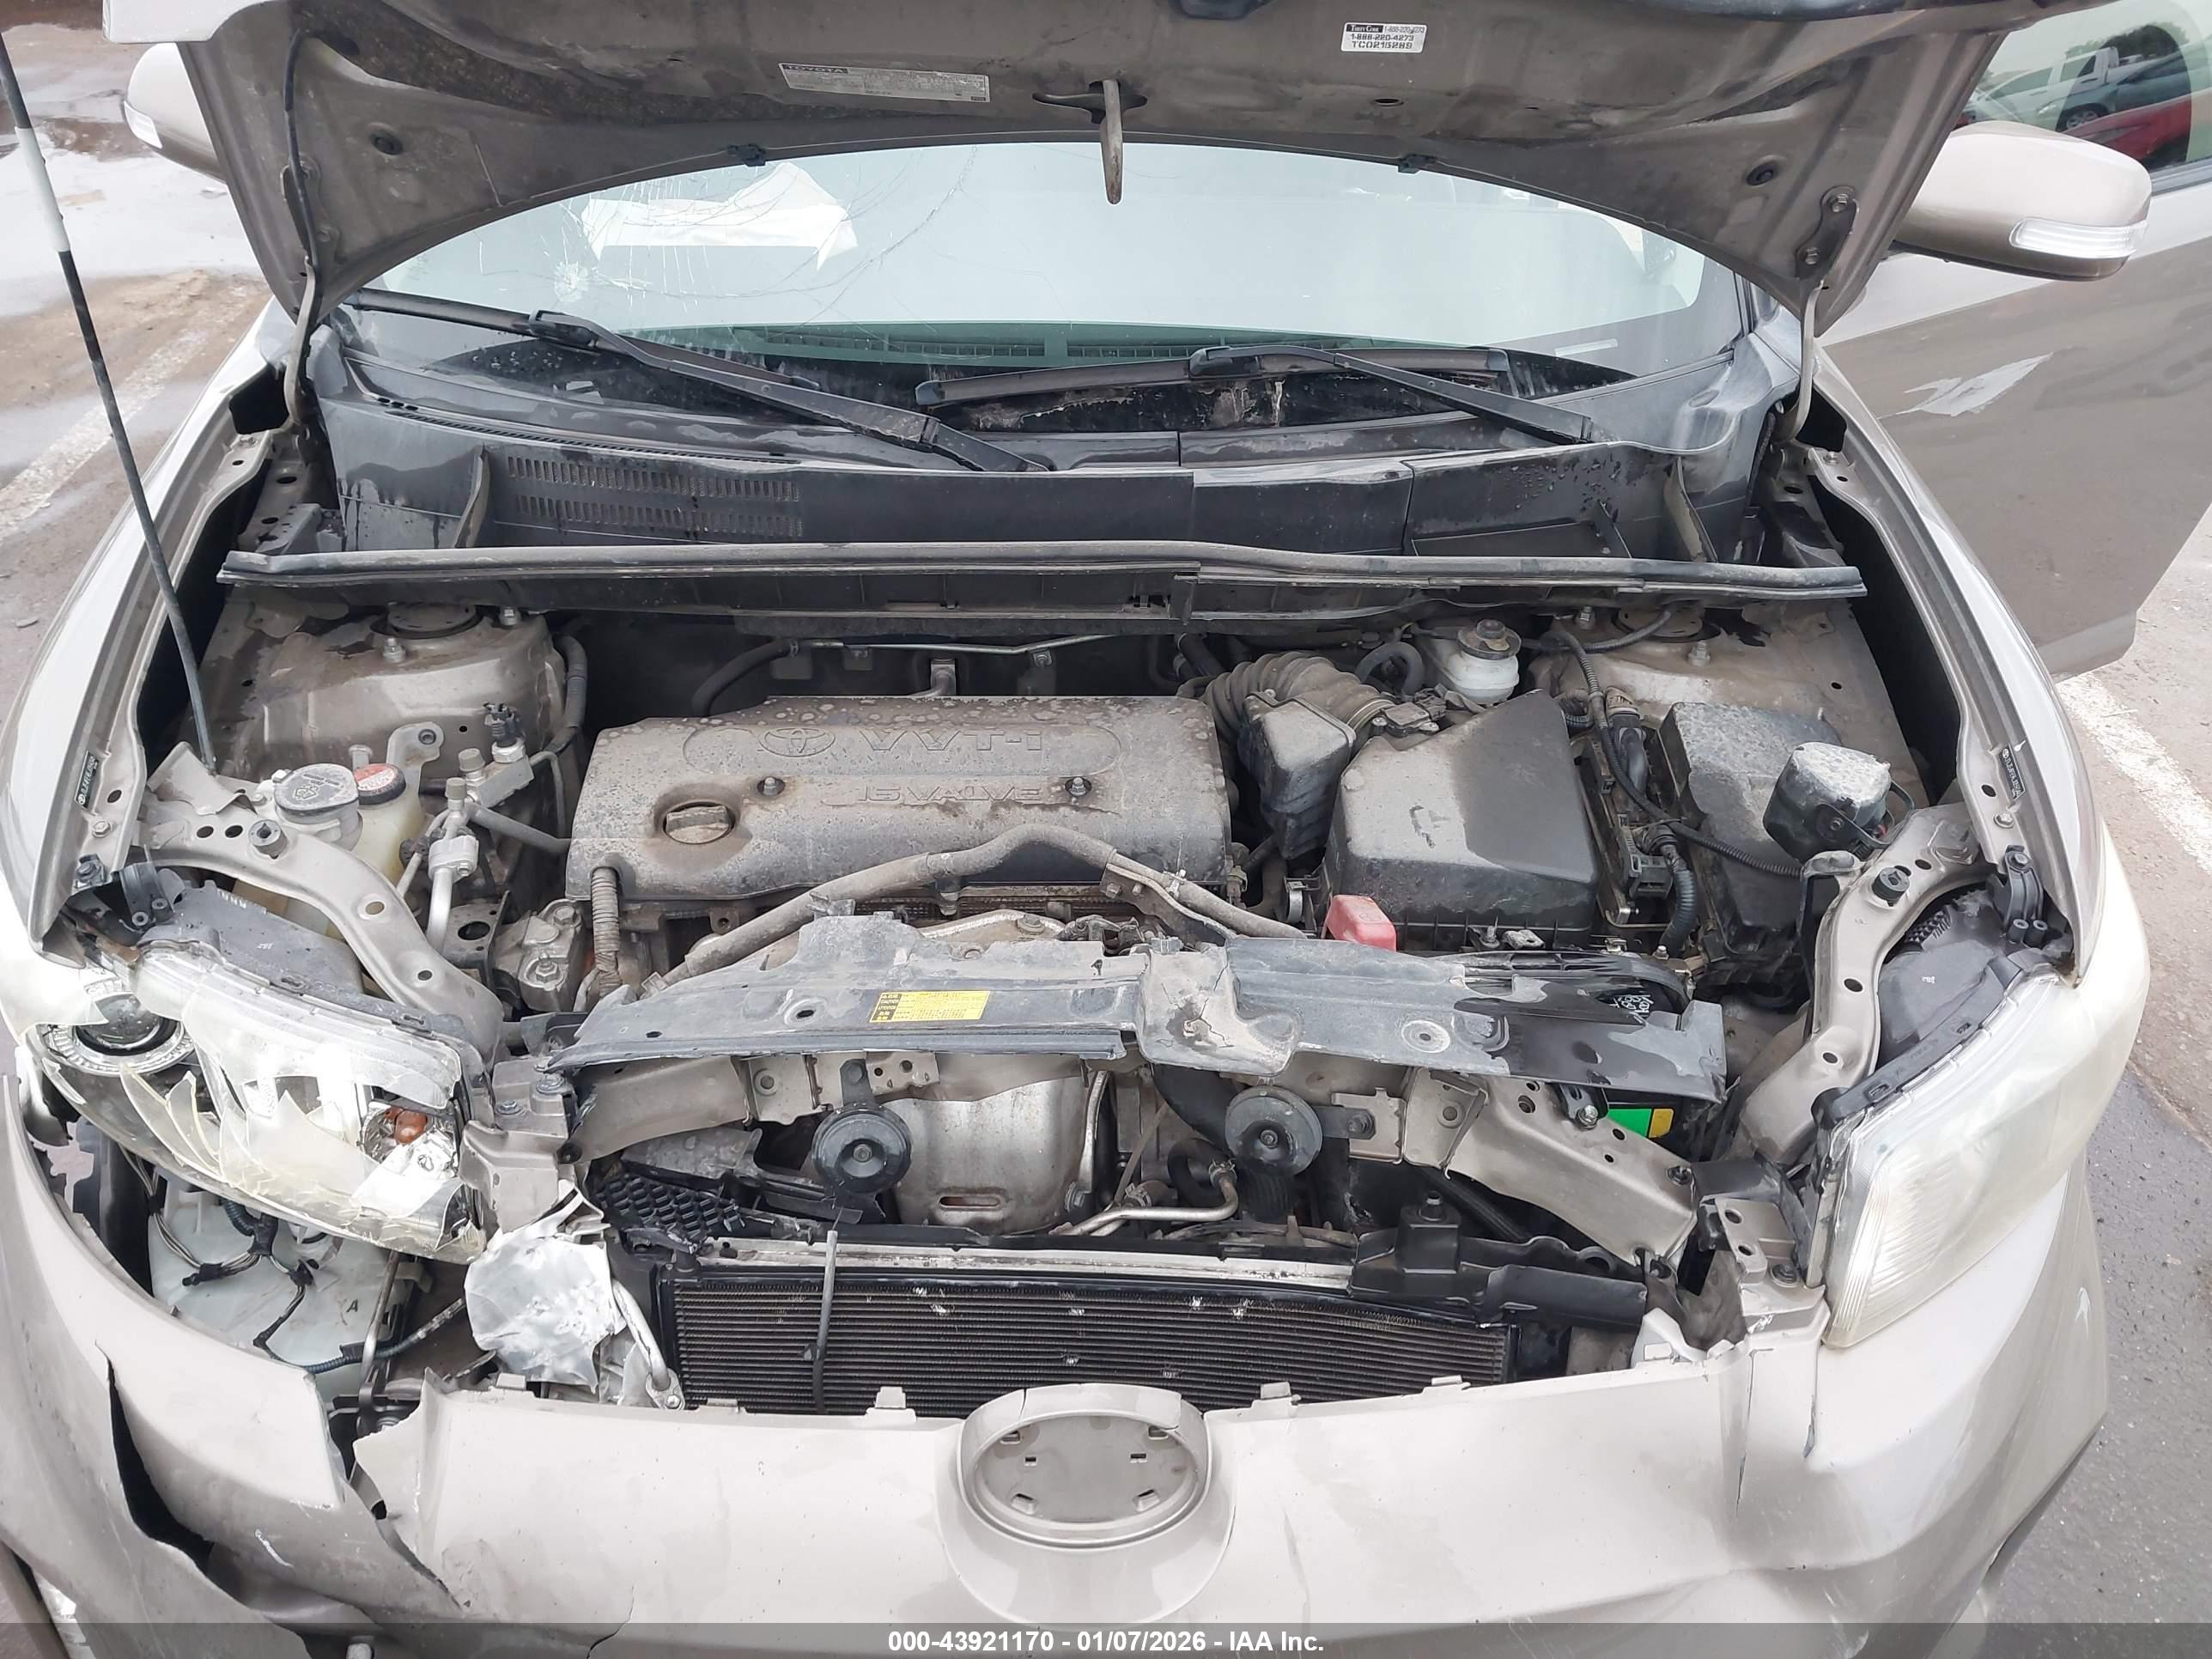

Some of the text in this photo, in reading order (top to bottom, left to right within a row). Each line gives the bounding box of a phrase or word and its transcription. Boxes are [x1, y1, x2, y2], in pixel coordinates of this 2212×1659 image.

[859, 783, 1041, 801] 16 VALVE
[346, 1298, 358, 1313] A
